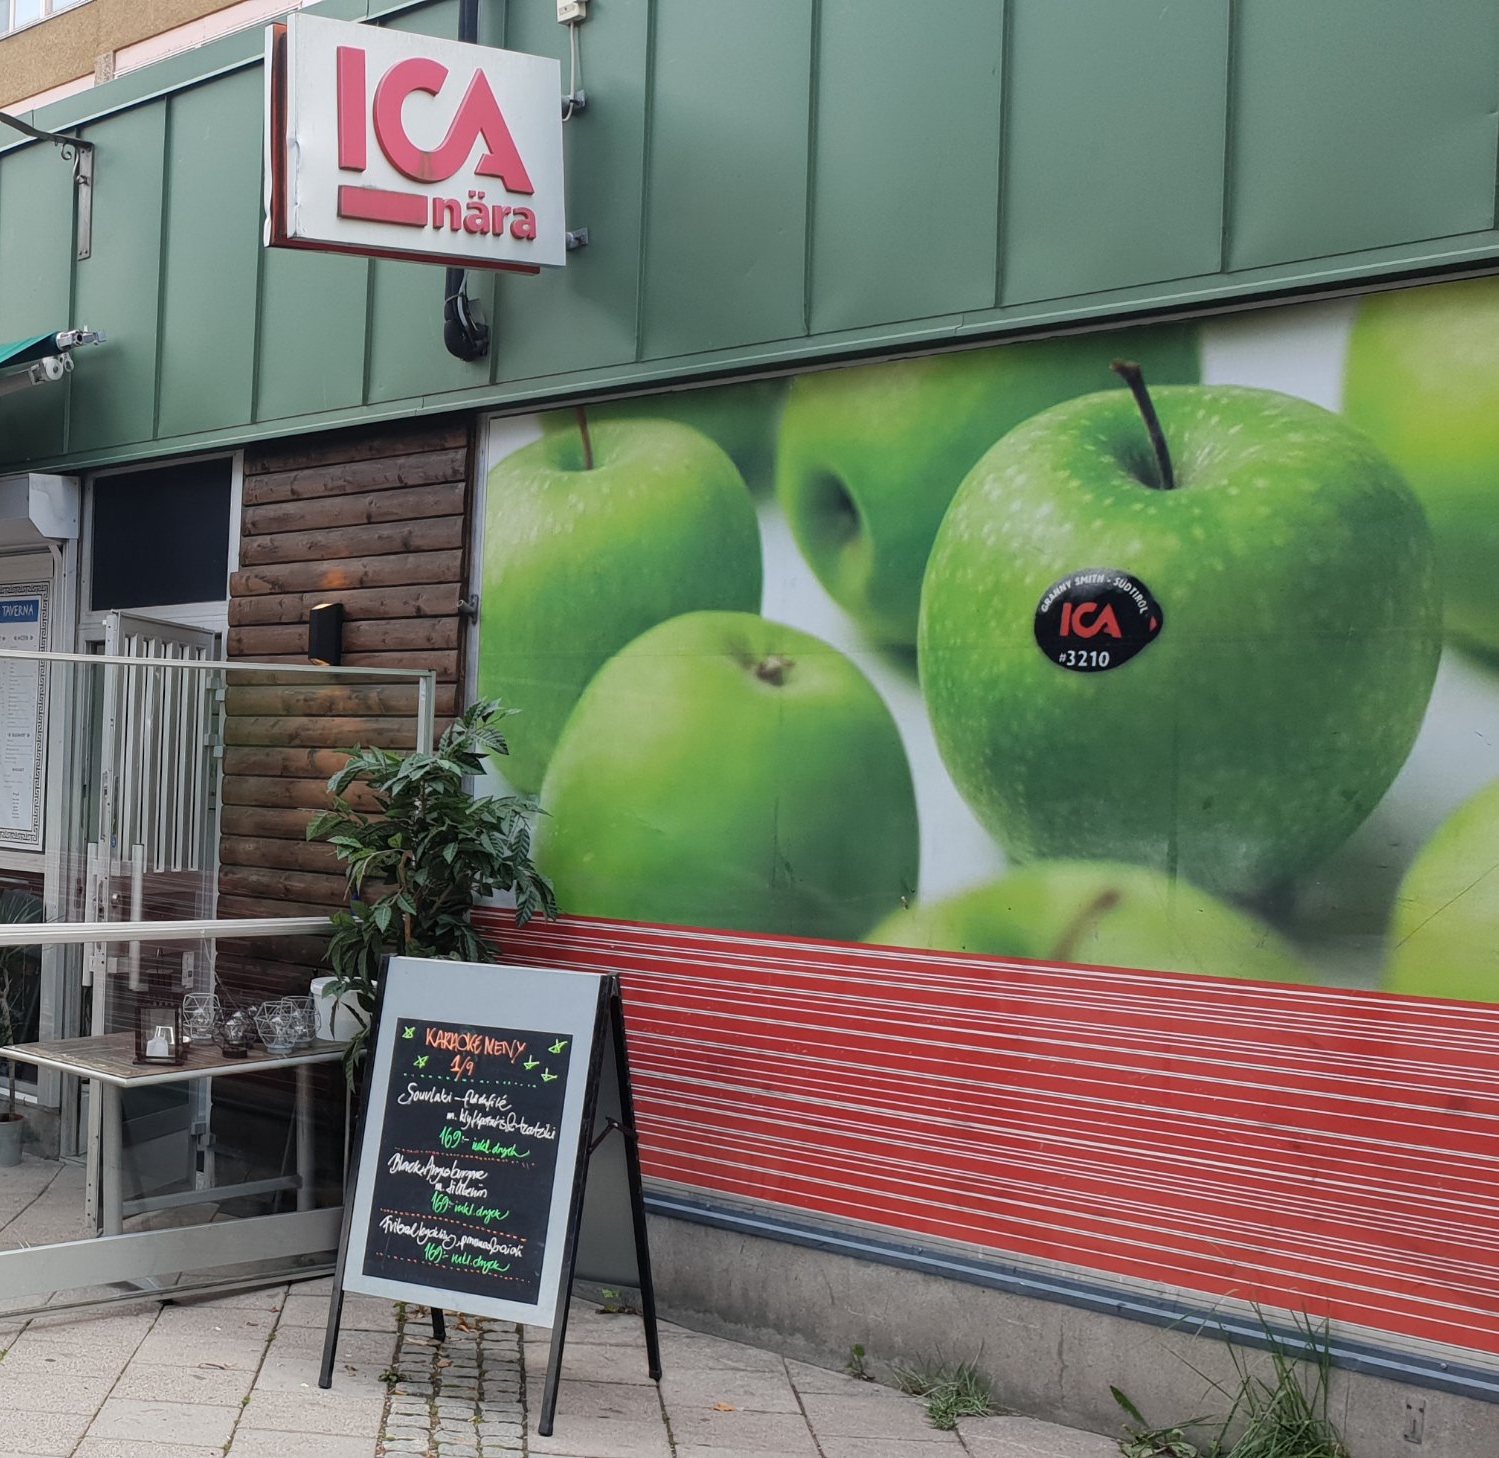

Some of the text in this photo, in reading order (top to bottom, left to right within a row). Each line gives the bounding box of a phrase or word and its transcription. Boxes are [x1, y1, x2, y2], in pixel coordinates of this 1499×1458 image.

[336, 46, 535, 195] ICA
[432, 190, 537, 240] nära
[1041, 580, 1072, 612] GRANNY
[1075, 574, 1105, 586] SMITH
[2, 604, 34, 617] TAVERNA
[1060, 602, 1122, 638] ICA
[1059, 650, 1110, 667] #3210
[425, 1027, 483, 1053] KARAOKE
[450, 1054, 475, 1081] 1/9
[397, 1082, 452, 1105] Souvlaki
[387, 1152, 424, 1176] Black
